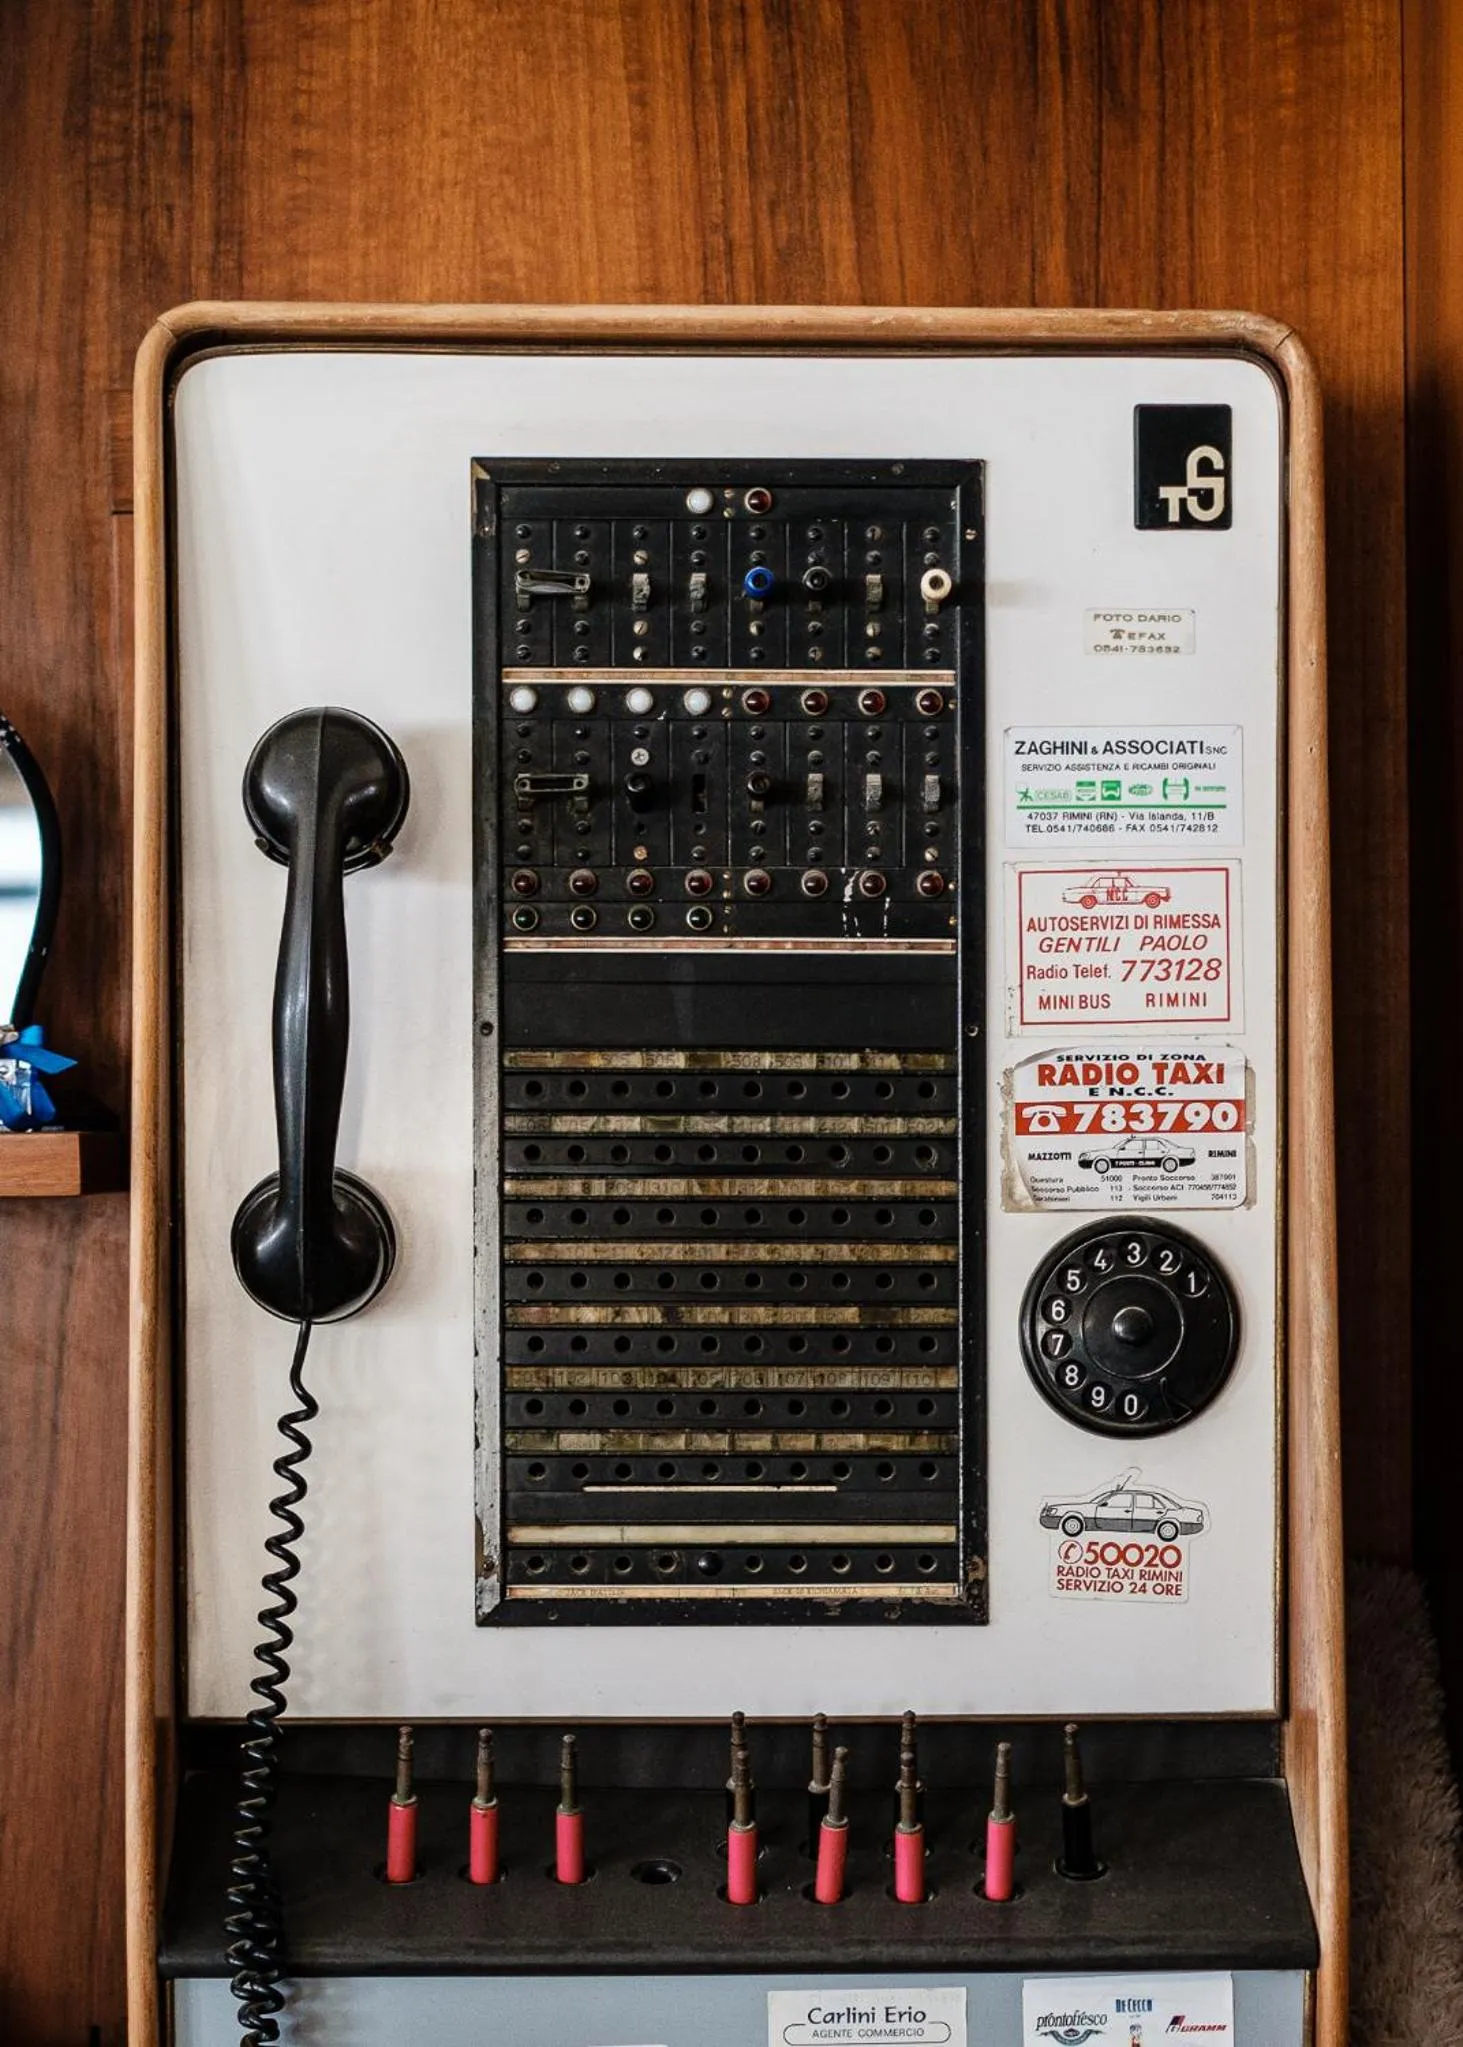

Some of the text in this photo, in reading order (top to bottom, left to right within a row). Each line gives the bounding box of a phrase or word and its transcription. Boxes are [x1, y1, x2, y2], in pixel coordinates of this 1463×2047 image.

[1093, 613, 1182, 622] FOTO DARIO
[1014, 740, 1228, 755] ZAGHINI & ASSOCIATI SNC
[1021, 762, 1216, 772] SERVIZIO ASSISTENZA E RICAMBI ORIGINALI
[1027, 812, 1058, 820] 47037
[1062, 812, 1092, 820] RIMINI
[1096, 811, 1118, 821] (RN)
[1129, 812, 1145, 820] Via
[1191, 811, 1214, 821] 11/B
[1125, 823, 1145, 832] FAX
[1026, 914, 1222, 932] AUTOSERVIZI DI RIMESSA
[1038, 934, 1208, 953] GENTILI PAOLO
[1026, 958, 1222, 982] Radio Telef. 773128
[1145, 992, 1208, 1008] RIMINI
[1056, 1054, 1130, 1063] SERVIZIO
[1037, 1063, 1225, 1086] RADIO TAXI
[1089, 1087, 1174, 1096] E N.C.C.
[1073, 1102, 1239, 1133] 783790
[1028, 1150, 1237, 1161] MAZZOTTI RIMINI
[1094, 1249, 1107, 1270] 4
[1127, 1242, 1140, 1264] 3
[1160, 1250, 1173, 1272] 2
[1067, 1270, 1081, 1291] 5
[1187, 1271, 1195, 1293] 1
[1051, 1300, 1065, 1321] 6
[1051, 1334, 1064, 1356] 7
[1065, 1365, 1079, 1386] 8
[1091, 1386, 1105, 1407] 9
[1124, 1394, 1137, 1415] 0
[1084, 1542, 1182, 1569] 50020
[1057, 1565, 1182, 1583] RADIO TAXI RIMINI
[1056, 1578, 1182, 1596] SERVIZIO 24 ORE
[808, 2006, 927, 2024] Carlini Erio
[812, 2027, 924, 2039] AGENTE COMMERCIO
